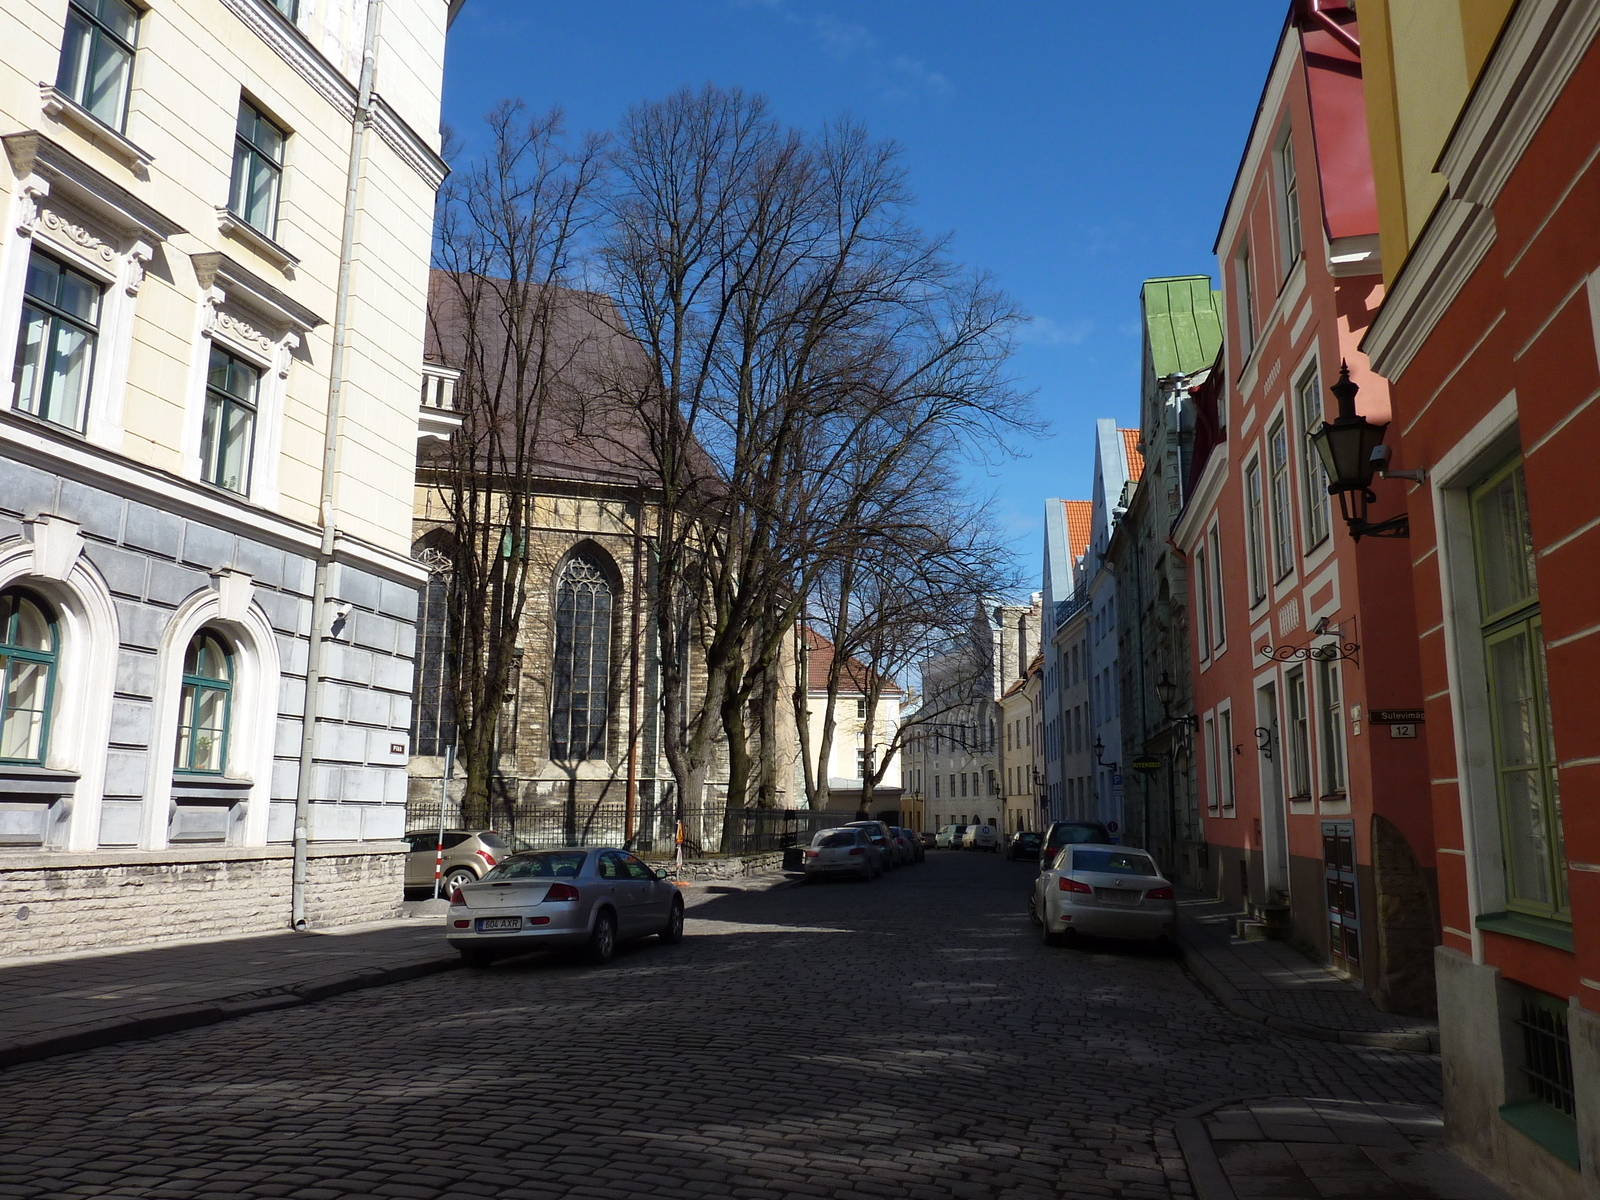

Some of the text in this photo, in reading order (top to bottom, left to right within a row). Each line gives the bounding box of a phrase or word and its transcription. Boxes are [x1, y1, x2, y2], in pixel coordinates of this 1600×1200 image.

[1396, 726, 1409, 736] 12
[1114, 775, 1120, 784] P
[485, 919, 518, 929] 604 AXR
